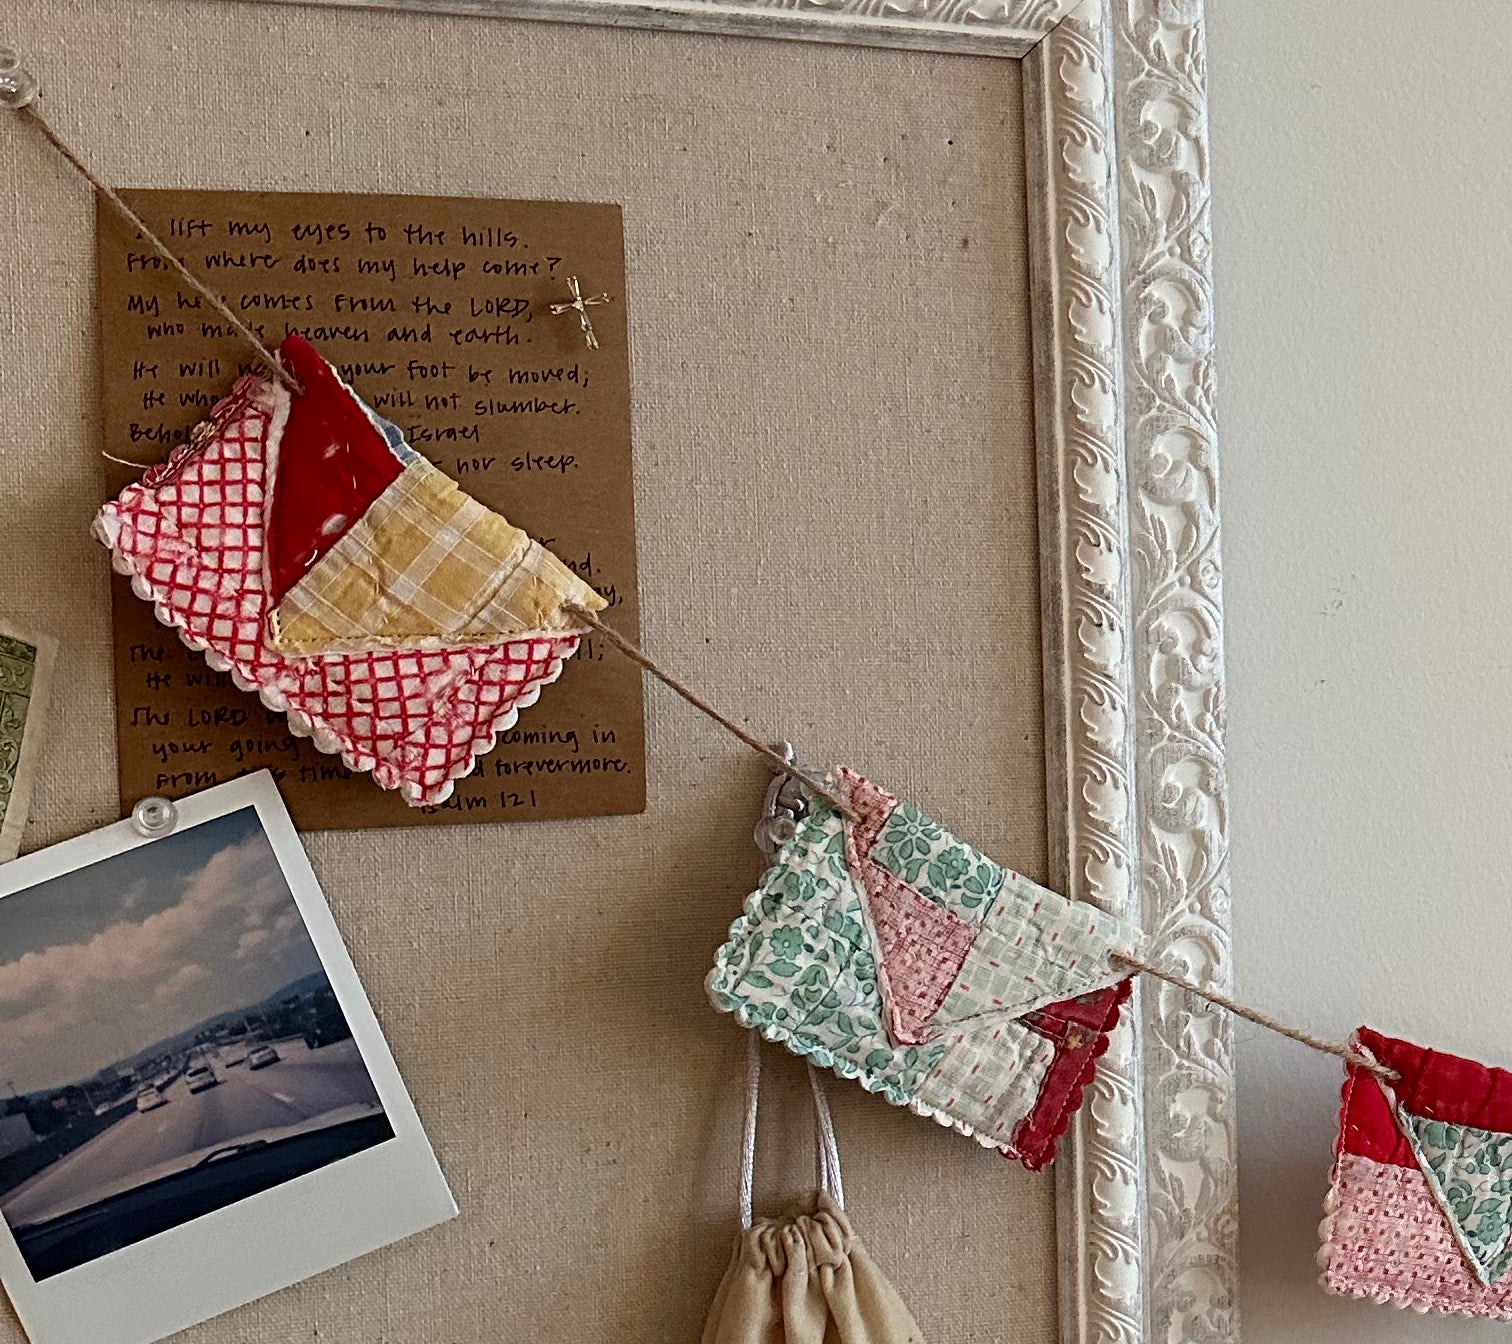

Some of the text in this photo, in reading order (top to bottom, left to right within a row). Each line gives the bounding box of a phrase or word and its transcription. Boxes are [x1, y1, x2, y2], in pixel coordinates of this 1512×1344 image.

[229, 221, 271, 243] my
[292, 223, 349, 244] eyes
[365, 222, 386, 243] to
[404, 223, 444, 245] the
[463, 226, 528, 248] hills.
[206, 251, 280, 269] where
[294, 255, 339, 273] does
[358, 258, 395, 281] my
[414, 257, 465, 280] help
[128, 294, 532, 323] My comes the LORD,
[148, 322, 531, 345] who heaven and earth.
[180, 359, 219, 377] will
[339, 361, 395, 384] your
[469, 365, 492, 384] be
[374, 391, 580, 415] will not slumber.
[407, 425, 479, 443] Israel
[457, 458, 495, 474] nor
[130, 644, 164, 662] The
[132, 707, 169, 727] The
[189, 709, 246, 727] LORD
[153, 724, 615, 762] your going coming in
[500, 790, 536, 808] 121
